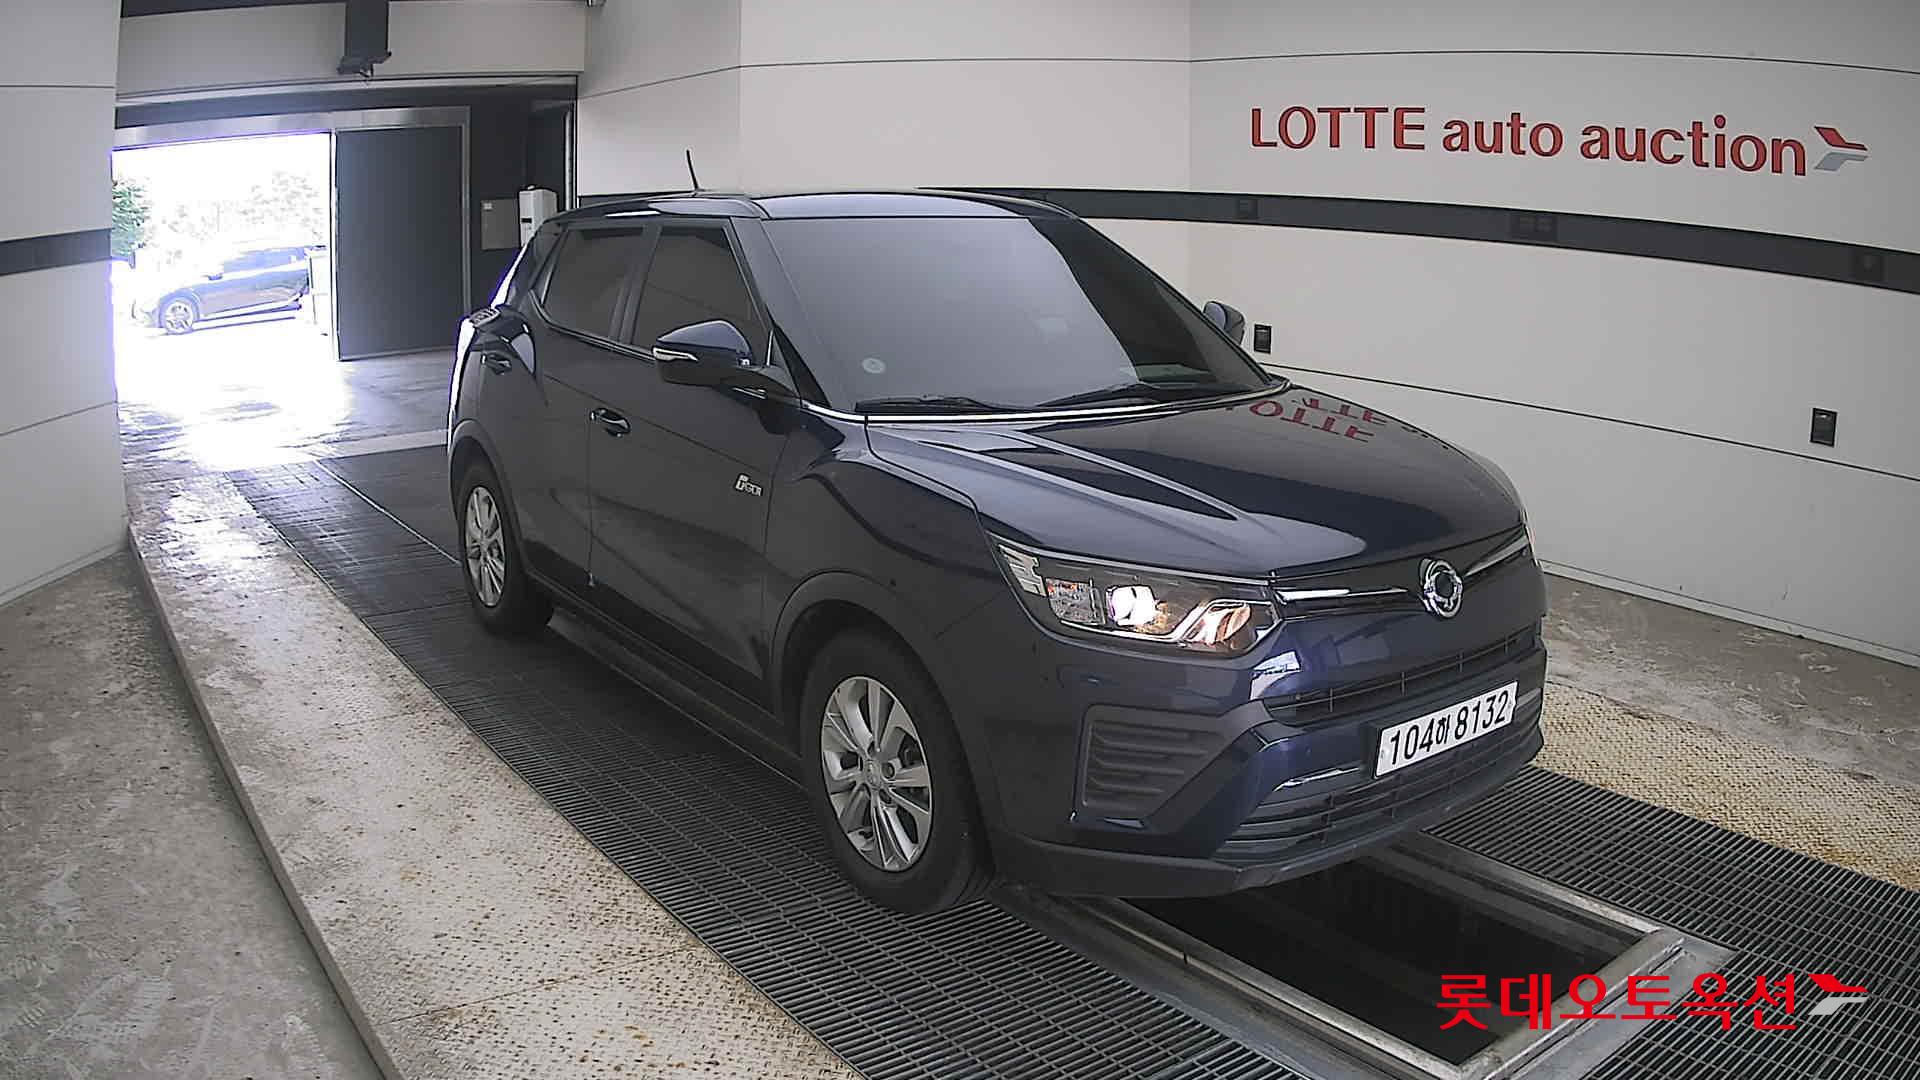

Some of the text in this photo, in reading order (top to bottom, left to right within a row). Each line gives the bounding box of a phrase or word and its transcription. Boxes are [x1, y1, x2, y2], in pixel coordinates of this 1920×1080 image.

[1250, 106, 1808, 177] LOTTE auto auction
[1454, 691, 1509, 740] 8132
